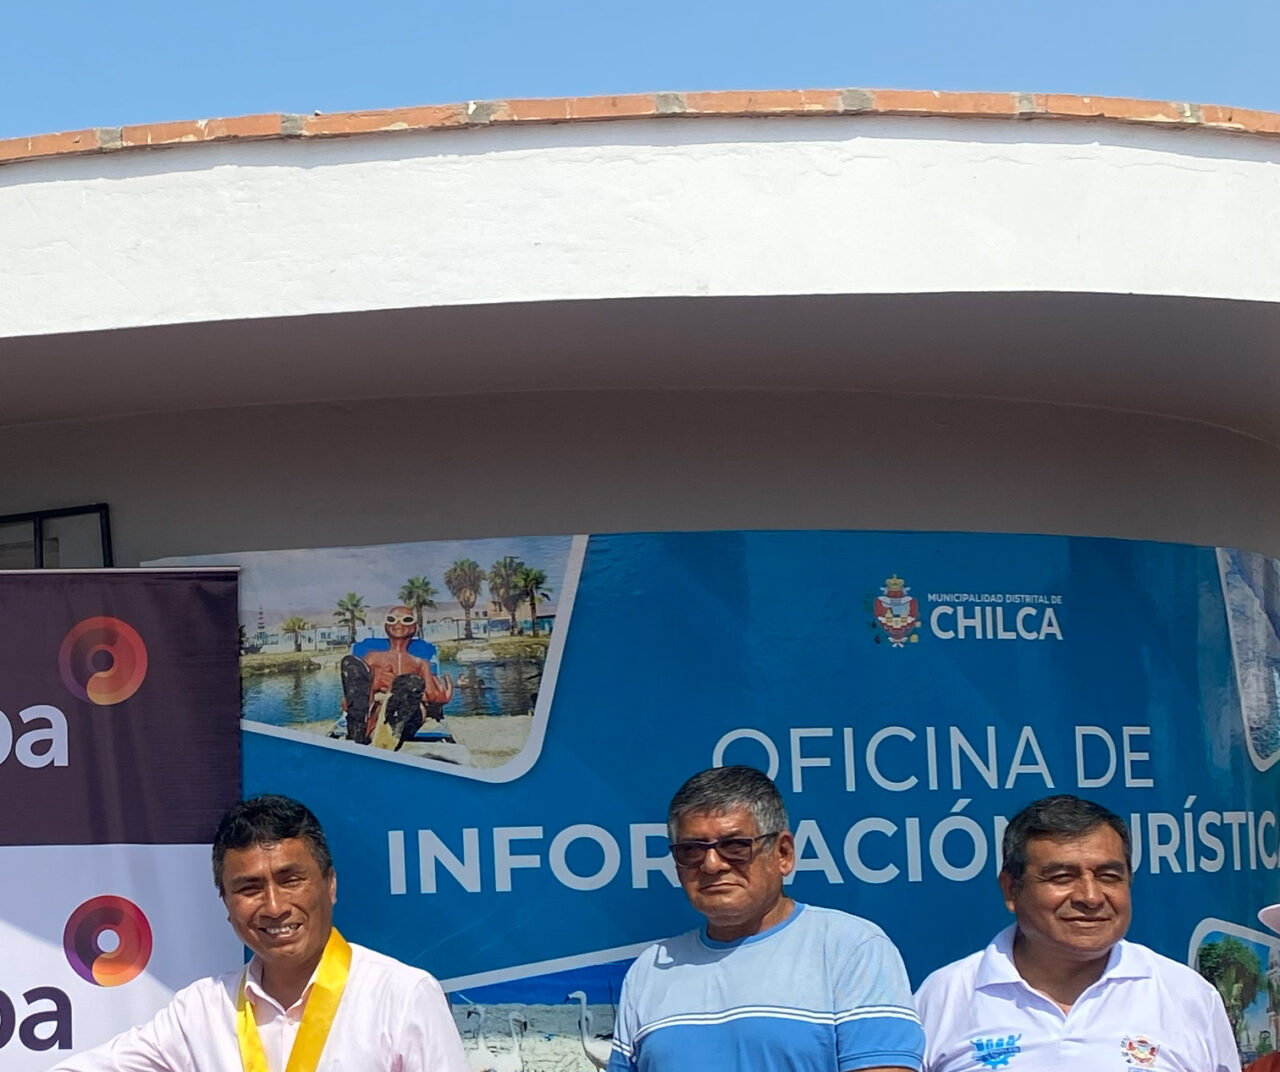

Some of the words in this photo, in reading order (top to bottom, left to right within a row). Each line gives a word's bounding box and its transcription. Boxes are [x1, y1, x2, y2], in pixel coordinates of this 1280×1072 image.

[927, 593, 1004, 604] MUNICIPALIDAD
[1005, 594, 1050, 604] DISTRITAL
[1051, 595, 1063, 604] DE
[930, 605, 1064, 641] CHILCA
[712, 725, 1056, 793] OFICINA
[1074, 725, 1155, 788] DE
[388, 798, 1010, 896] INFORACIÓ
